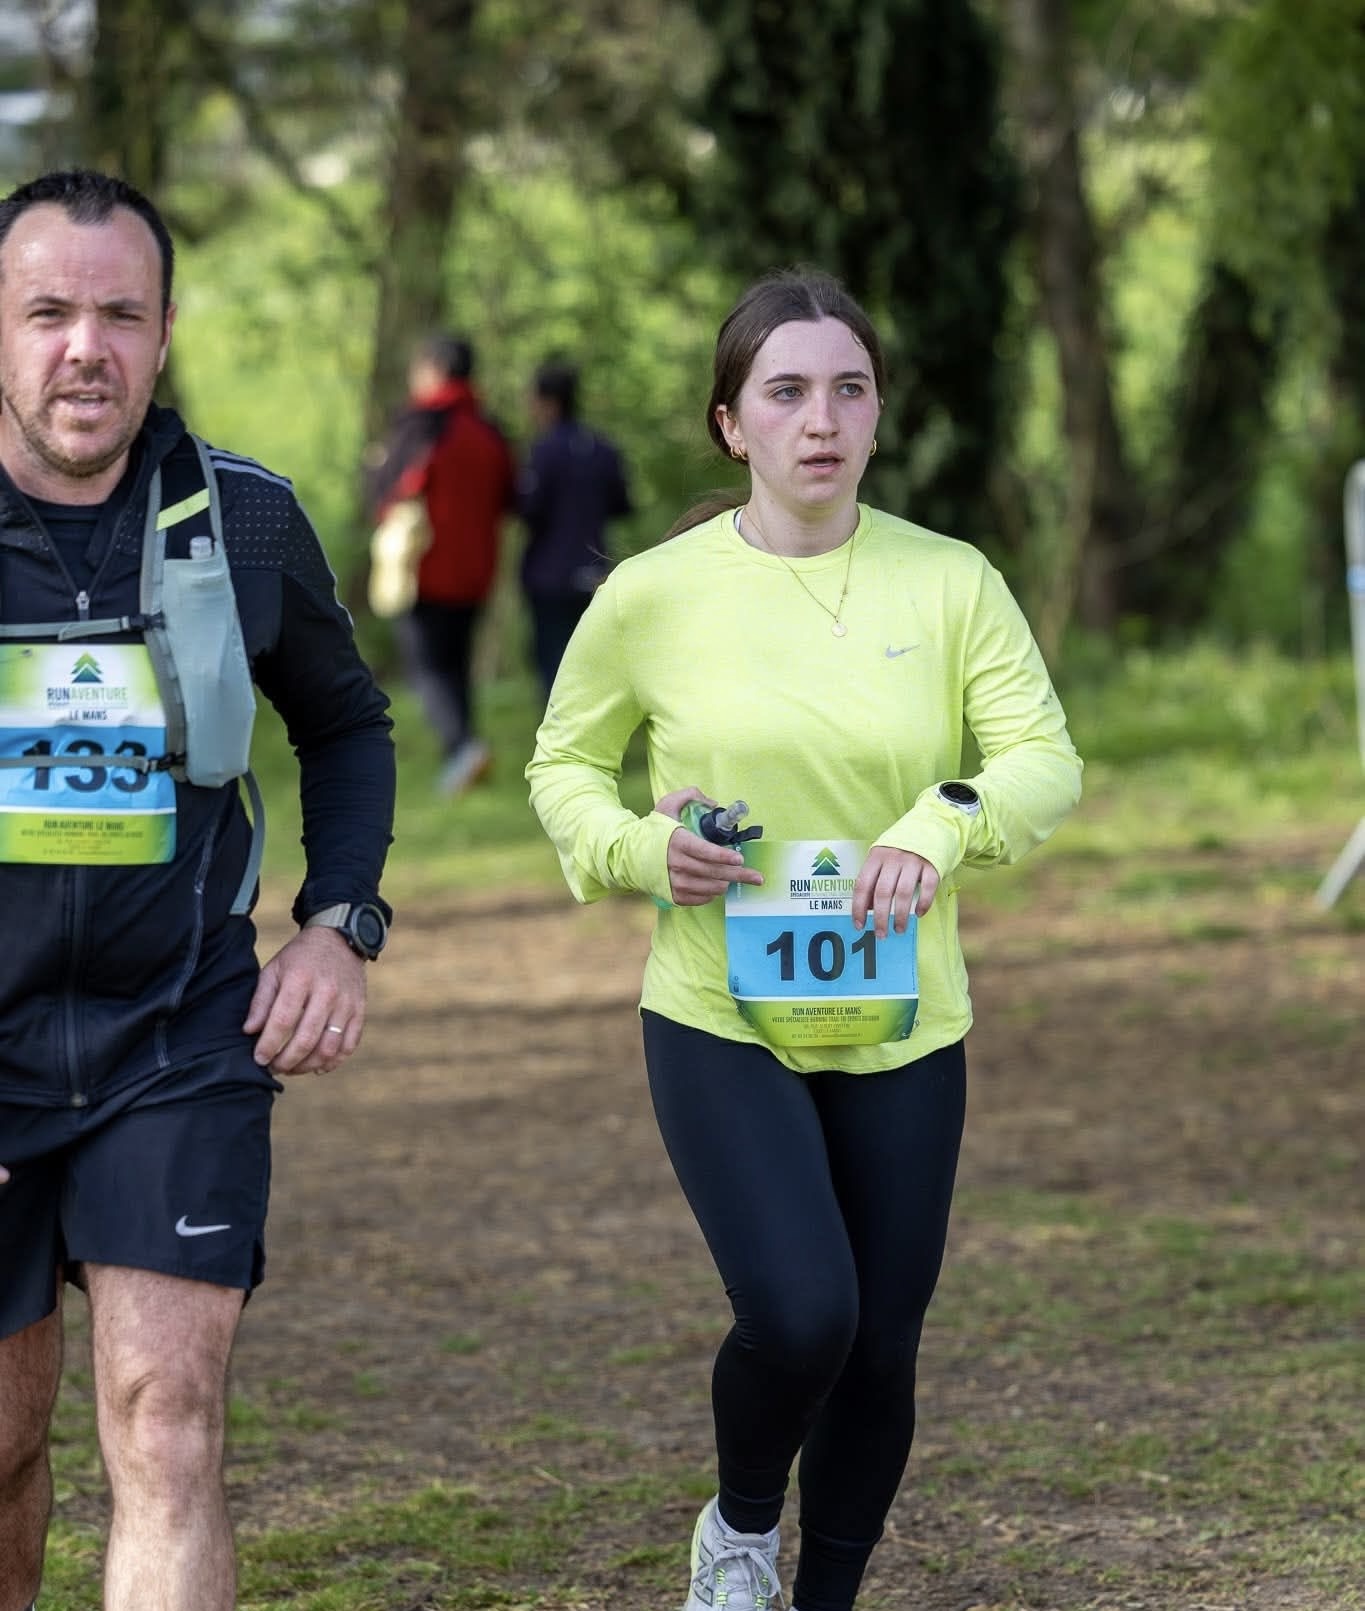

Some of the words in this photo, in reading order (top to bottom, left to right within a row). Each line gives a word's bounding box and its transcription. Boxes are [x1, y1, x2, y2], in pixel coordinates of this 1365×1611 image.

[70, 710, 79, 721] LE
[82, 710, 108, 721] MANS
[23, 739, 149, 793] 133
[809, 900, 819, 910] LE
[821, 900, 843, 910] MANS
[767, 930, 876, 982] 101
[792, 1007, 805, 1016] RUN
[806, 1007, 836, 1016] AVENTURE
[837, 1007, 844, 1016] LE
[845, 1007, 862, 1016] MANS
